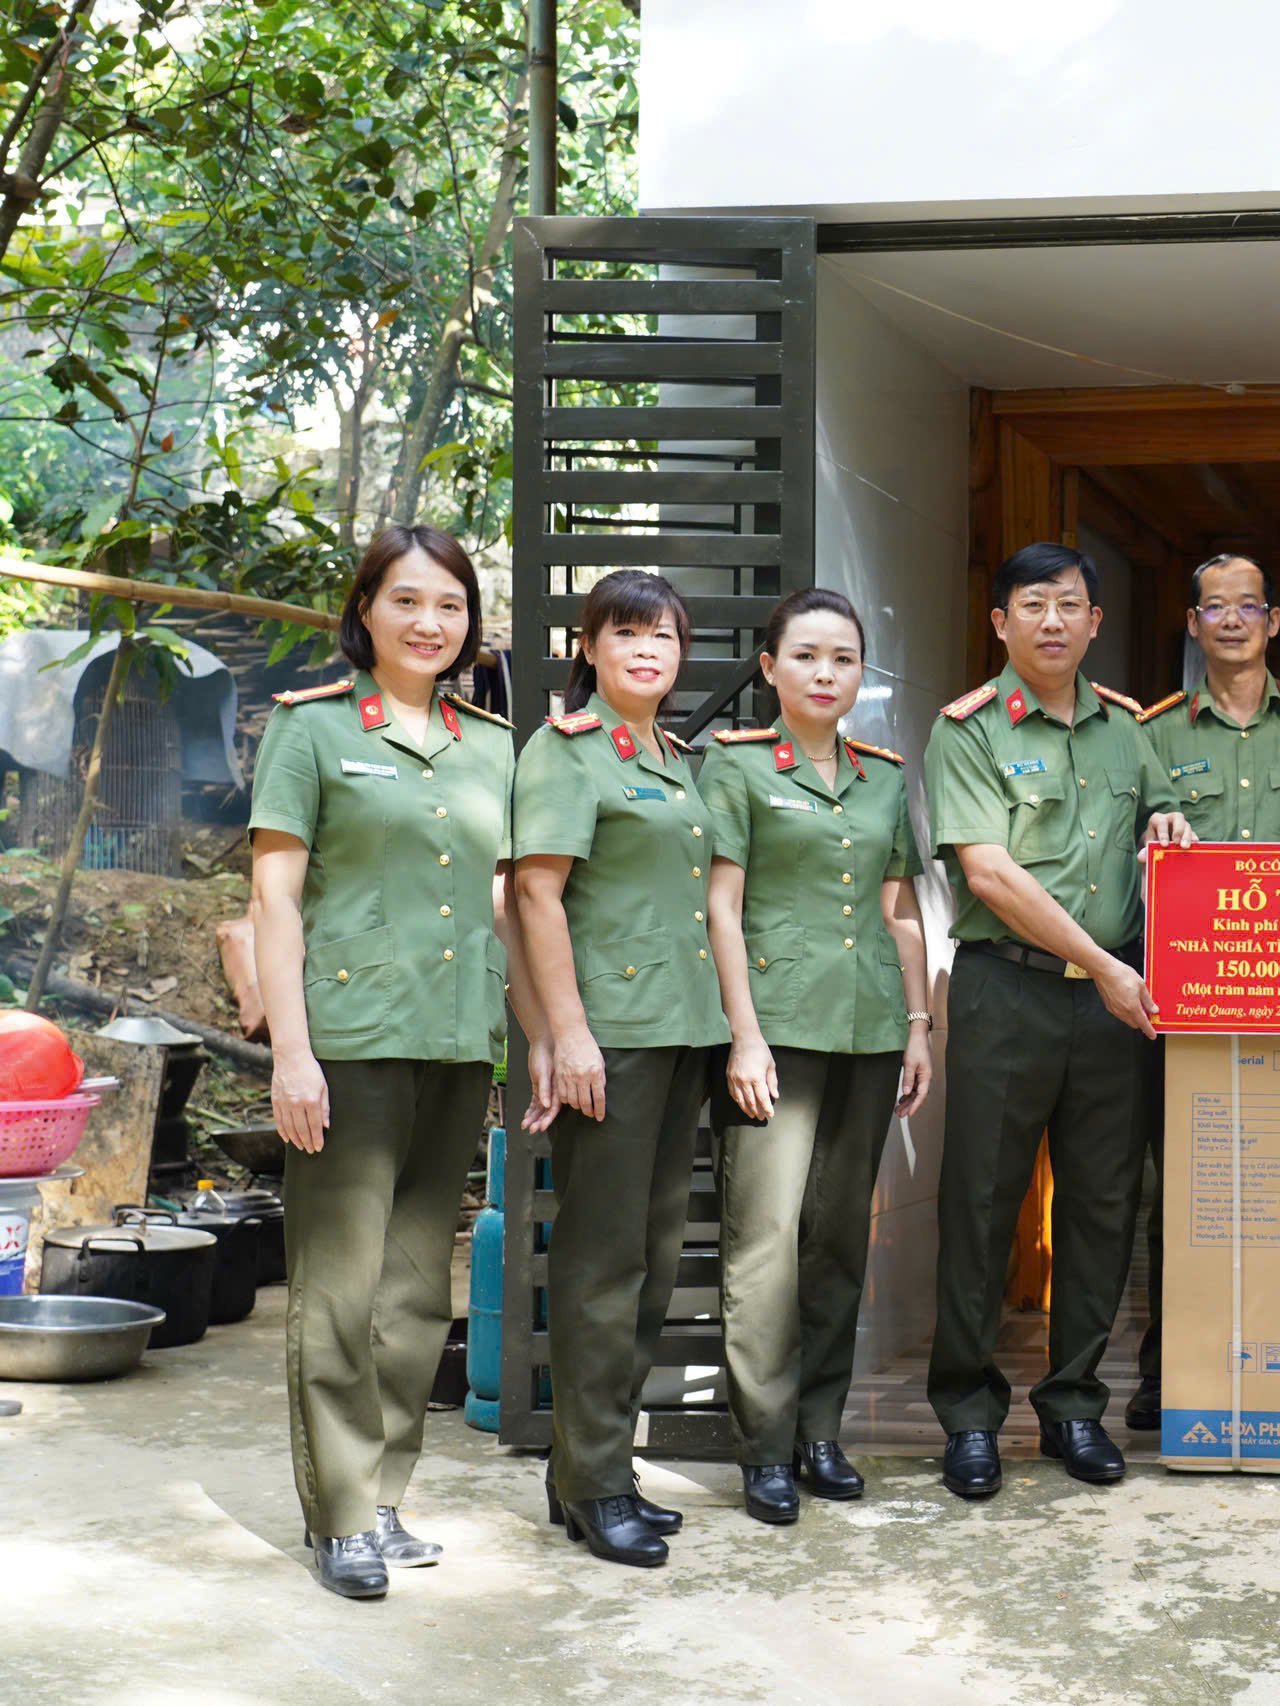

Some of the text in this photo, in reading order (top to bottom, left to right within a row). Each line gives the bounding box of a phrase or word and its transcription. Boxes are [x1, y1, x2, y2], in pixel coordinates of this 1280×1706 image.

[1235, 858, 1257, 873] BỘ
[1216, 878, 1267, 911] HỖ
[1213, 918, 1250, 931] Kinh
[1254, 919, 1279, 934] phí
[1169, 937, 1210, 952] “NHÀ
[1213, 939, 1264, 953] NGHĨA
[1182, 982, 1211, 998] (Một
[1215, 984, 1245, 996] trăm
[1247, 984, 1275, 996] năm
[1175, 1003, 1207, 1018] Tuyên
[1209, 1004, 1246, 1019] Quang,
[1249, 1005, 1274, 1018] ngày
[1237, 1056, 1264, 1065] erial
